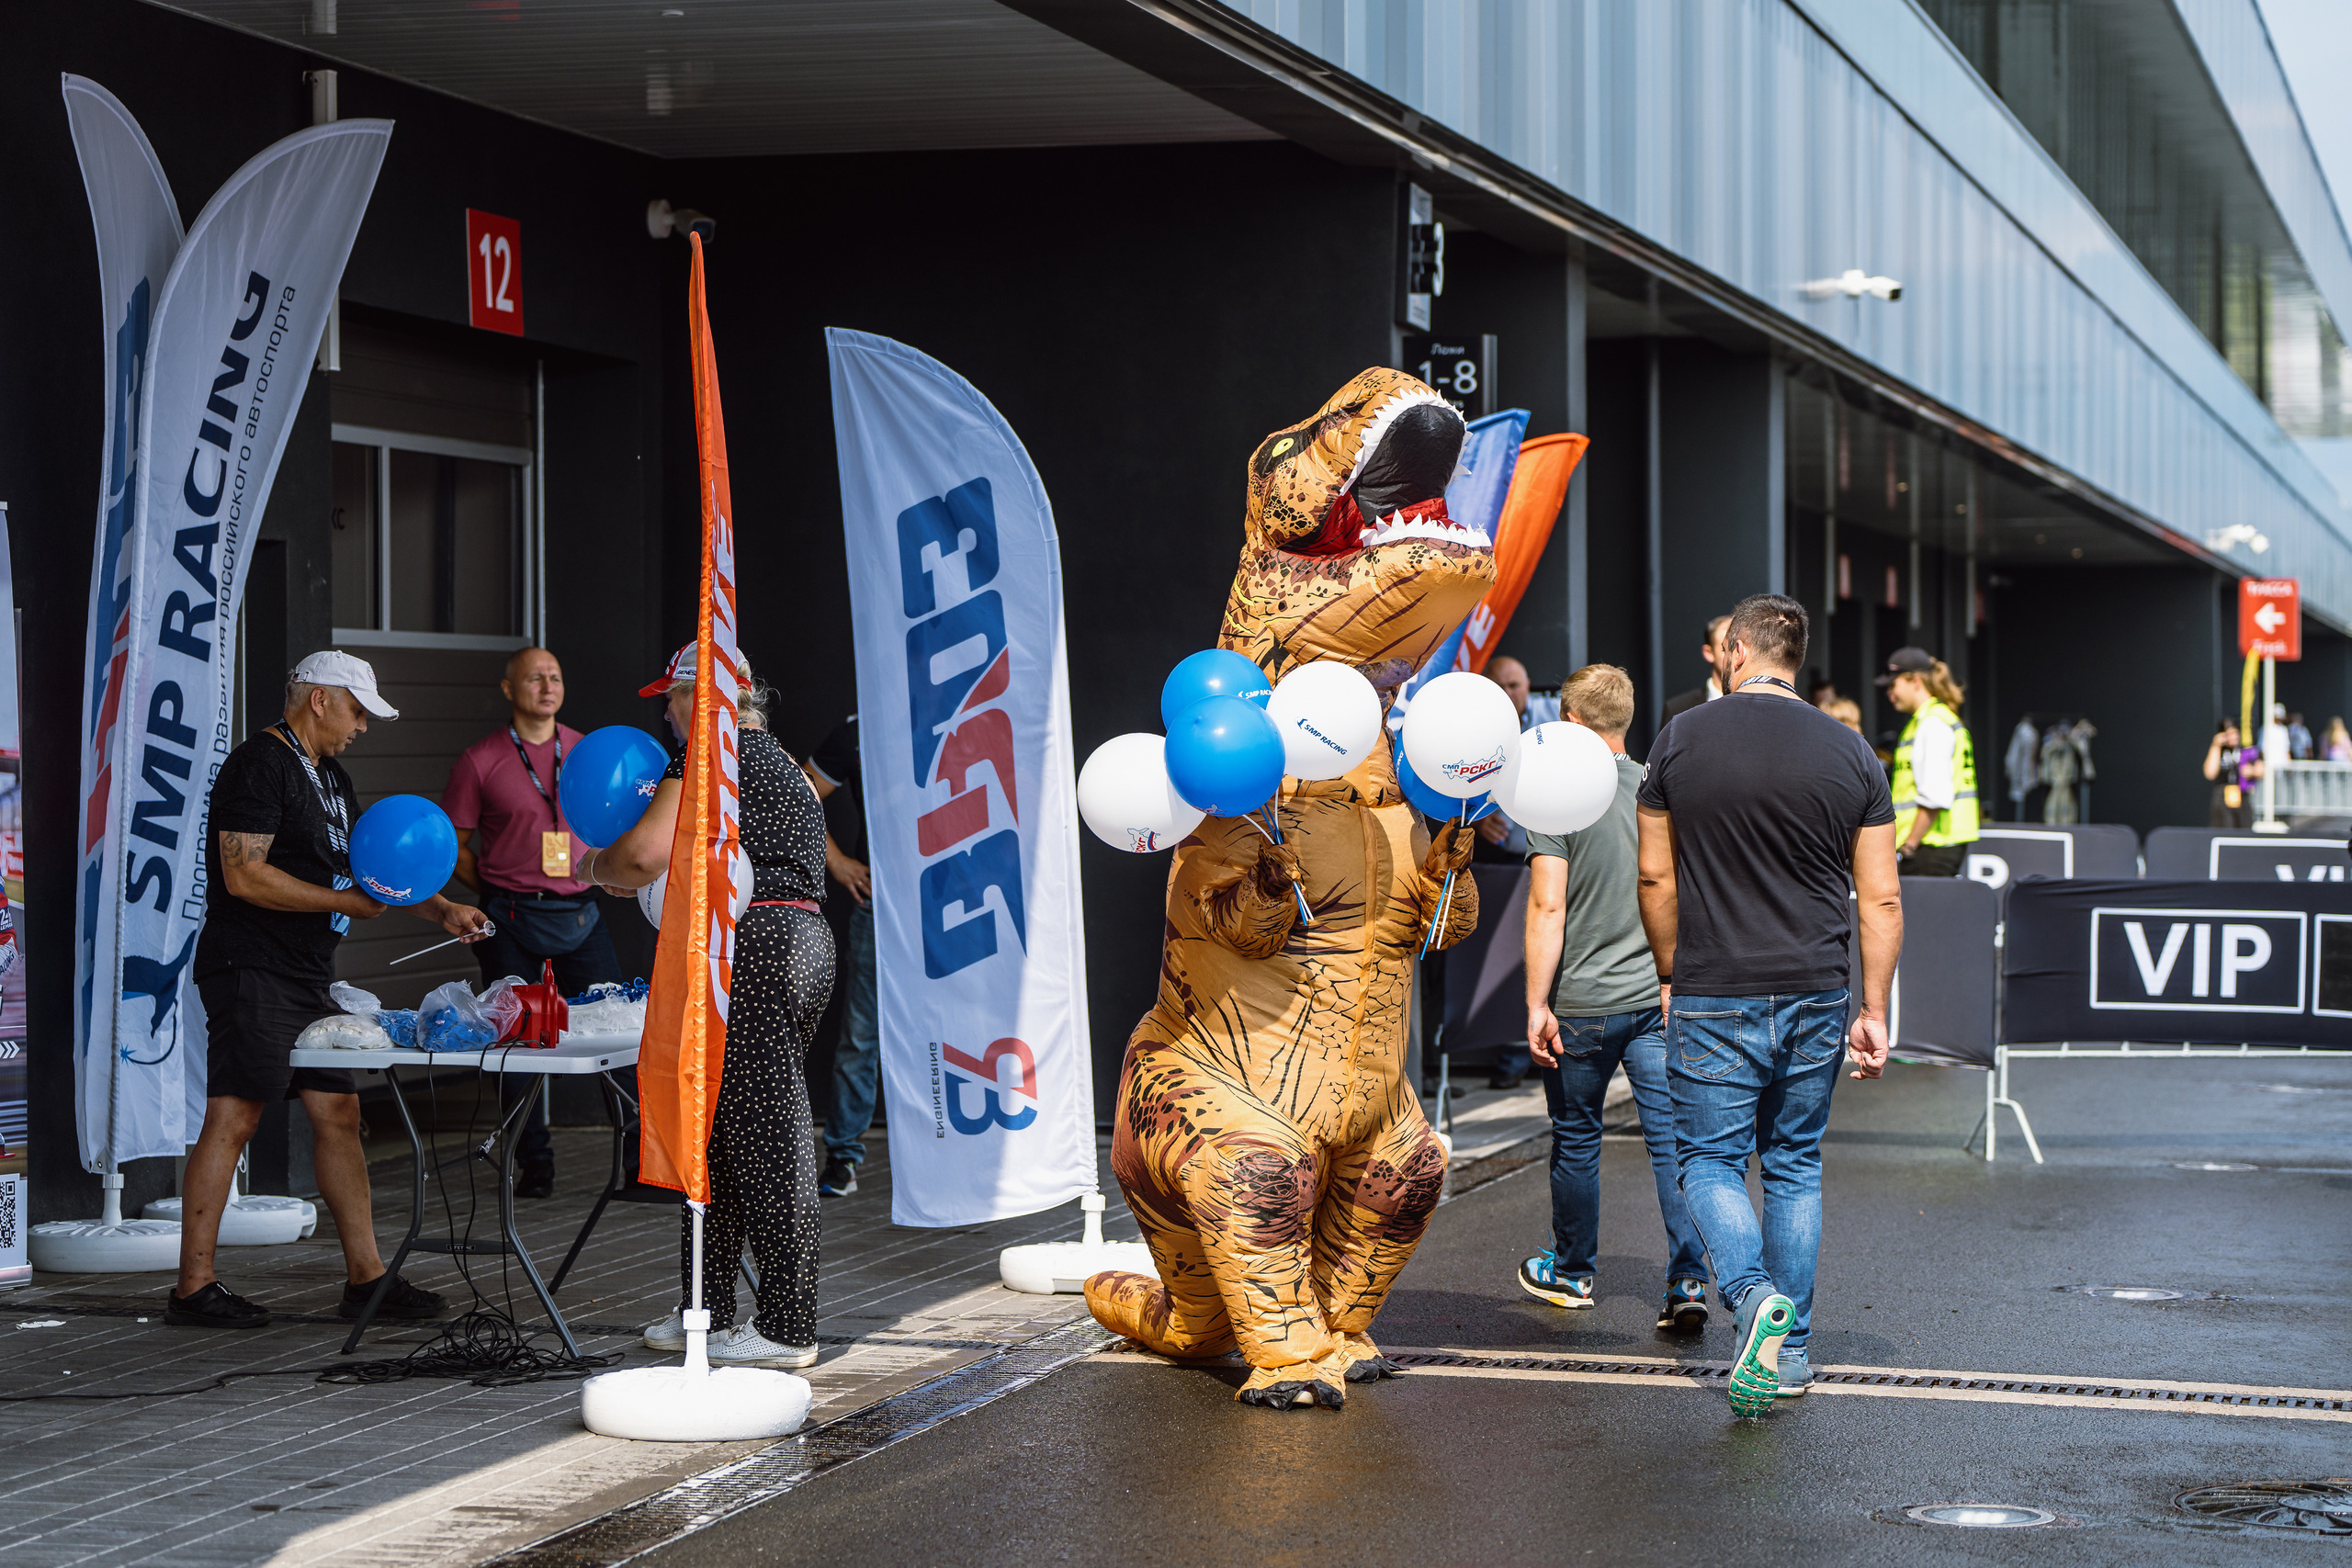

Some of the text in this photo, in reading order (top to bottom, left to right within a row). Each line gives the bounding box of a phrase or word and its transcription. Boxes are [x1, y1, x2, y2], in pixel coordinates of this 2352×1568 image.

[479, 232, 514, 313] 12
[1419, 359, 1478, 395] 1-8
[220, 445, 252, 621] российского
[243, 286, 296, 439] автоспорта
[125, 270, 270, 914] SMP RACING
[1304, 724, 1348, 755] SMP RACING
[1459, 760, 1497, 775] РСКГ
[369, 880, 402, 897] РСКГ
[2122, 921, 2272, 998] VIP
